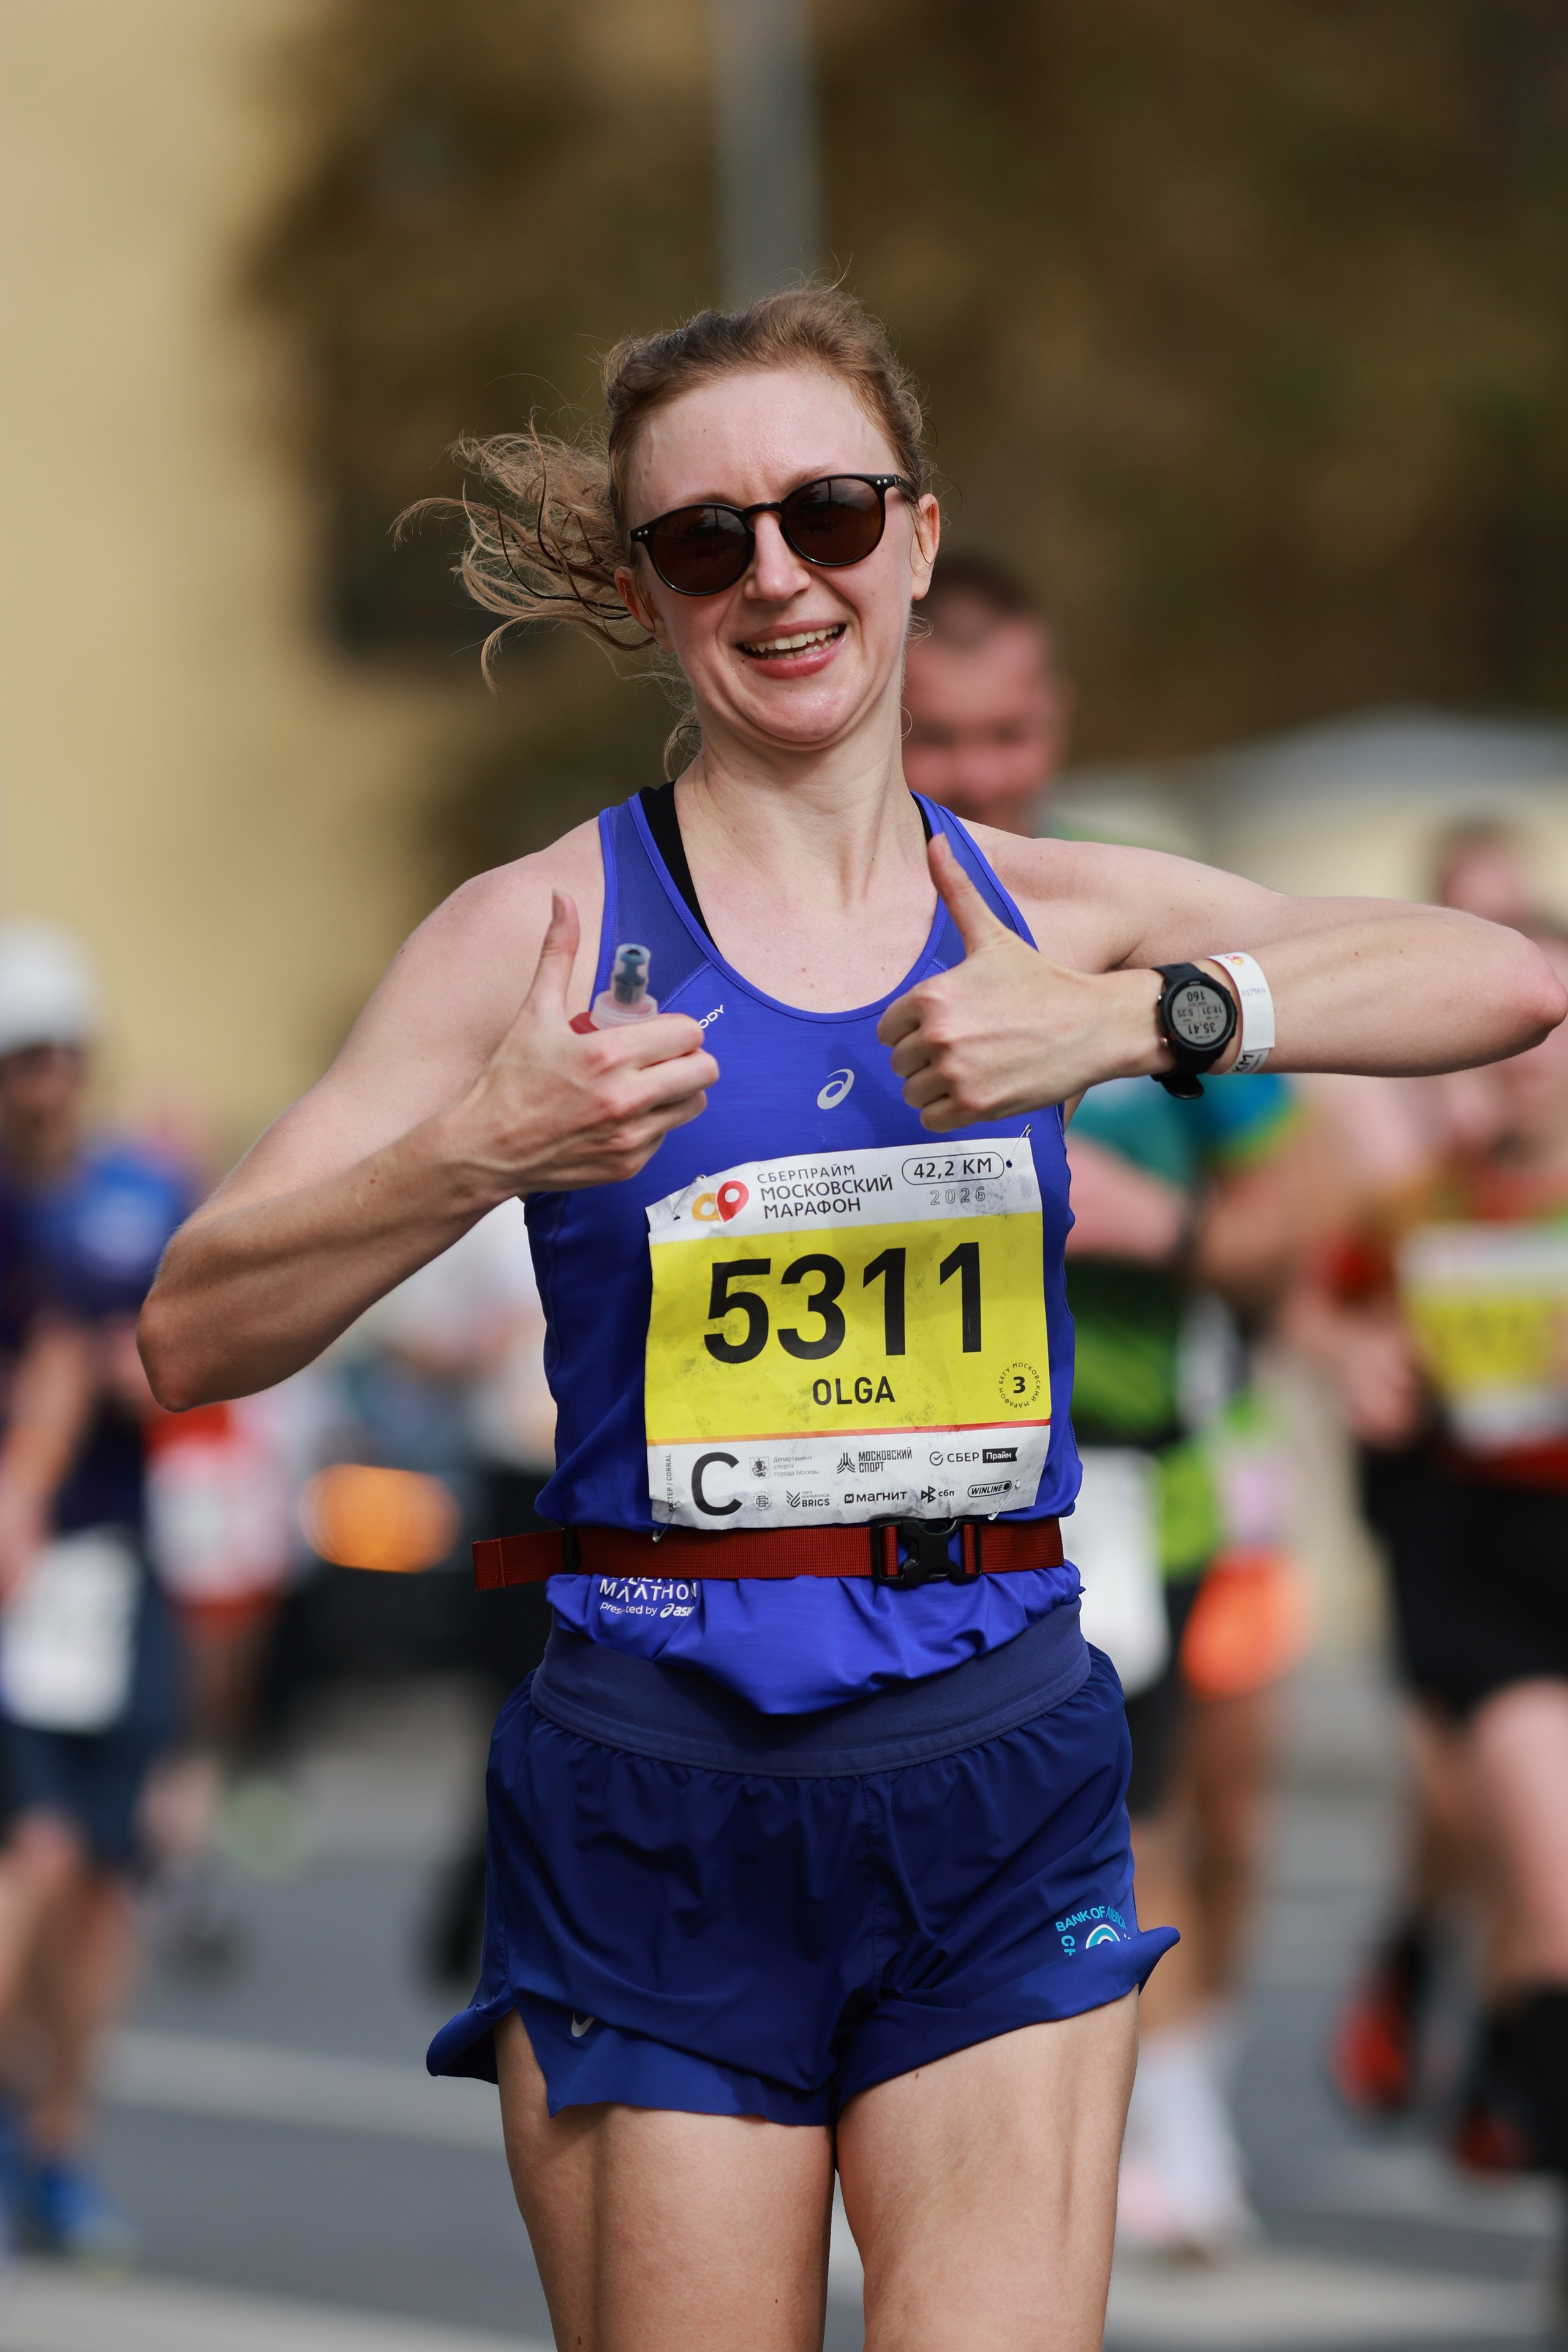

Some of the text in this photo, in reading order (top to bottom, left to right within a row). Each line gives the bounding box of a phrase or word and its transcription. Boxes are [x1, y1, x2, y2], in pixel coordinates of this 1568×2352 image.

[1187, 990, 1205, 1001] 160
[698, 1004, 724, 1029] ODY
[1188, 1022, 1216, 1035] 35.41
[757, 1164, 855, 1183] СБЕРПРАЙМ
[914, 1161, 954, 1179] 42,2
[760, 1174, 893, 1201] МОСКОВСКИЙ
[930, 1186, 986, 1205] 2026
[764, 1197, 861, 1219] МАРАФОН
[704, 1242, 982, 1364] 5311
[812, 1376, 895, 1405] OLGA
[1013, 1376, 1026, 1394] 3
[859, 1447, 912, 1462] МОСКОВСКИЙ
[947, 1451, 1012, 1463] СБЕР Прайм
[859, 1461, 884, 1473] СПОРТ
[856, 1491, 907, 1502] магнит
[971, 1484, 1003, 1495] WINLINE
[802, 1498, 830, 1507] BRICS
[645, 1605, 657, 1616] by
[1055, 1910, 1091, 1932] BANK
[1090, 1906, 1106, 1919] OF
